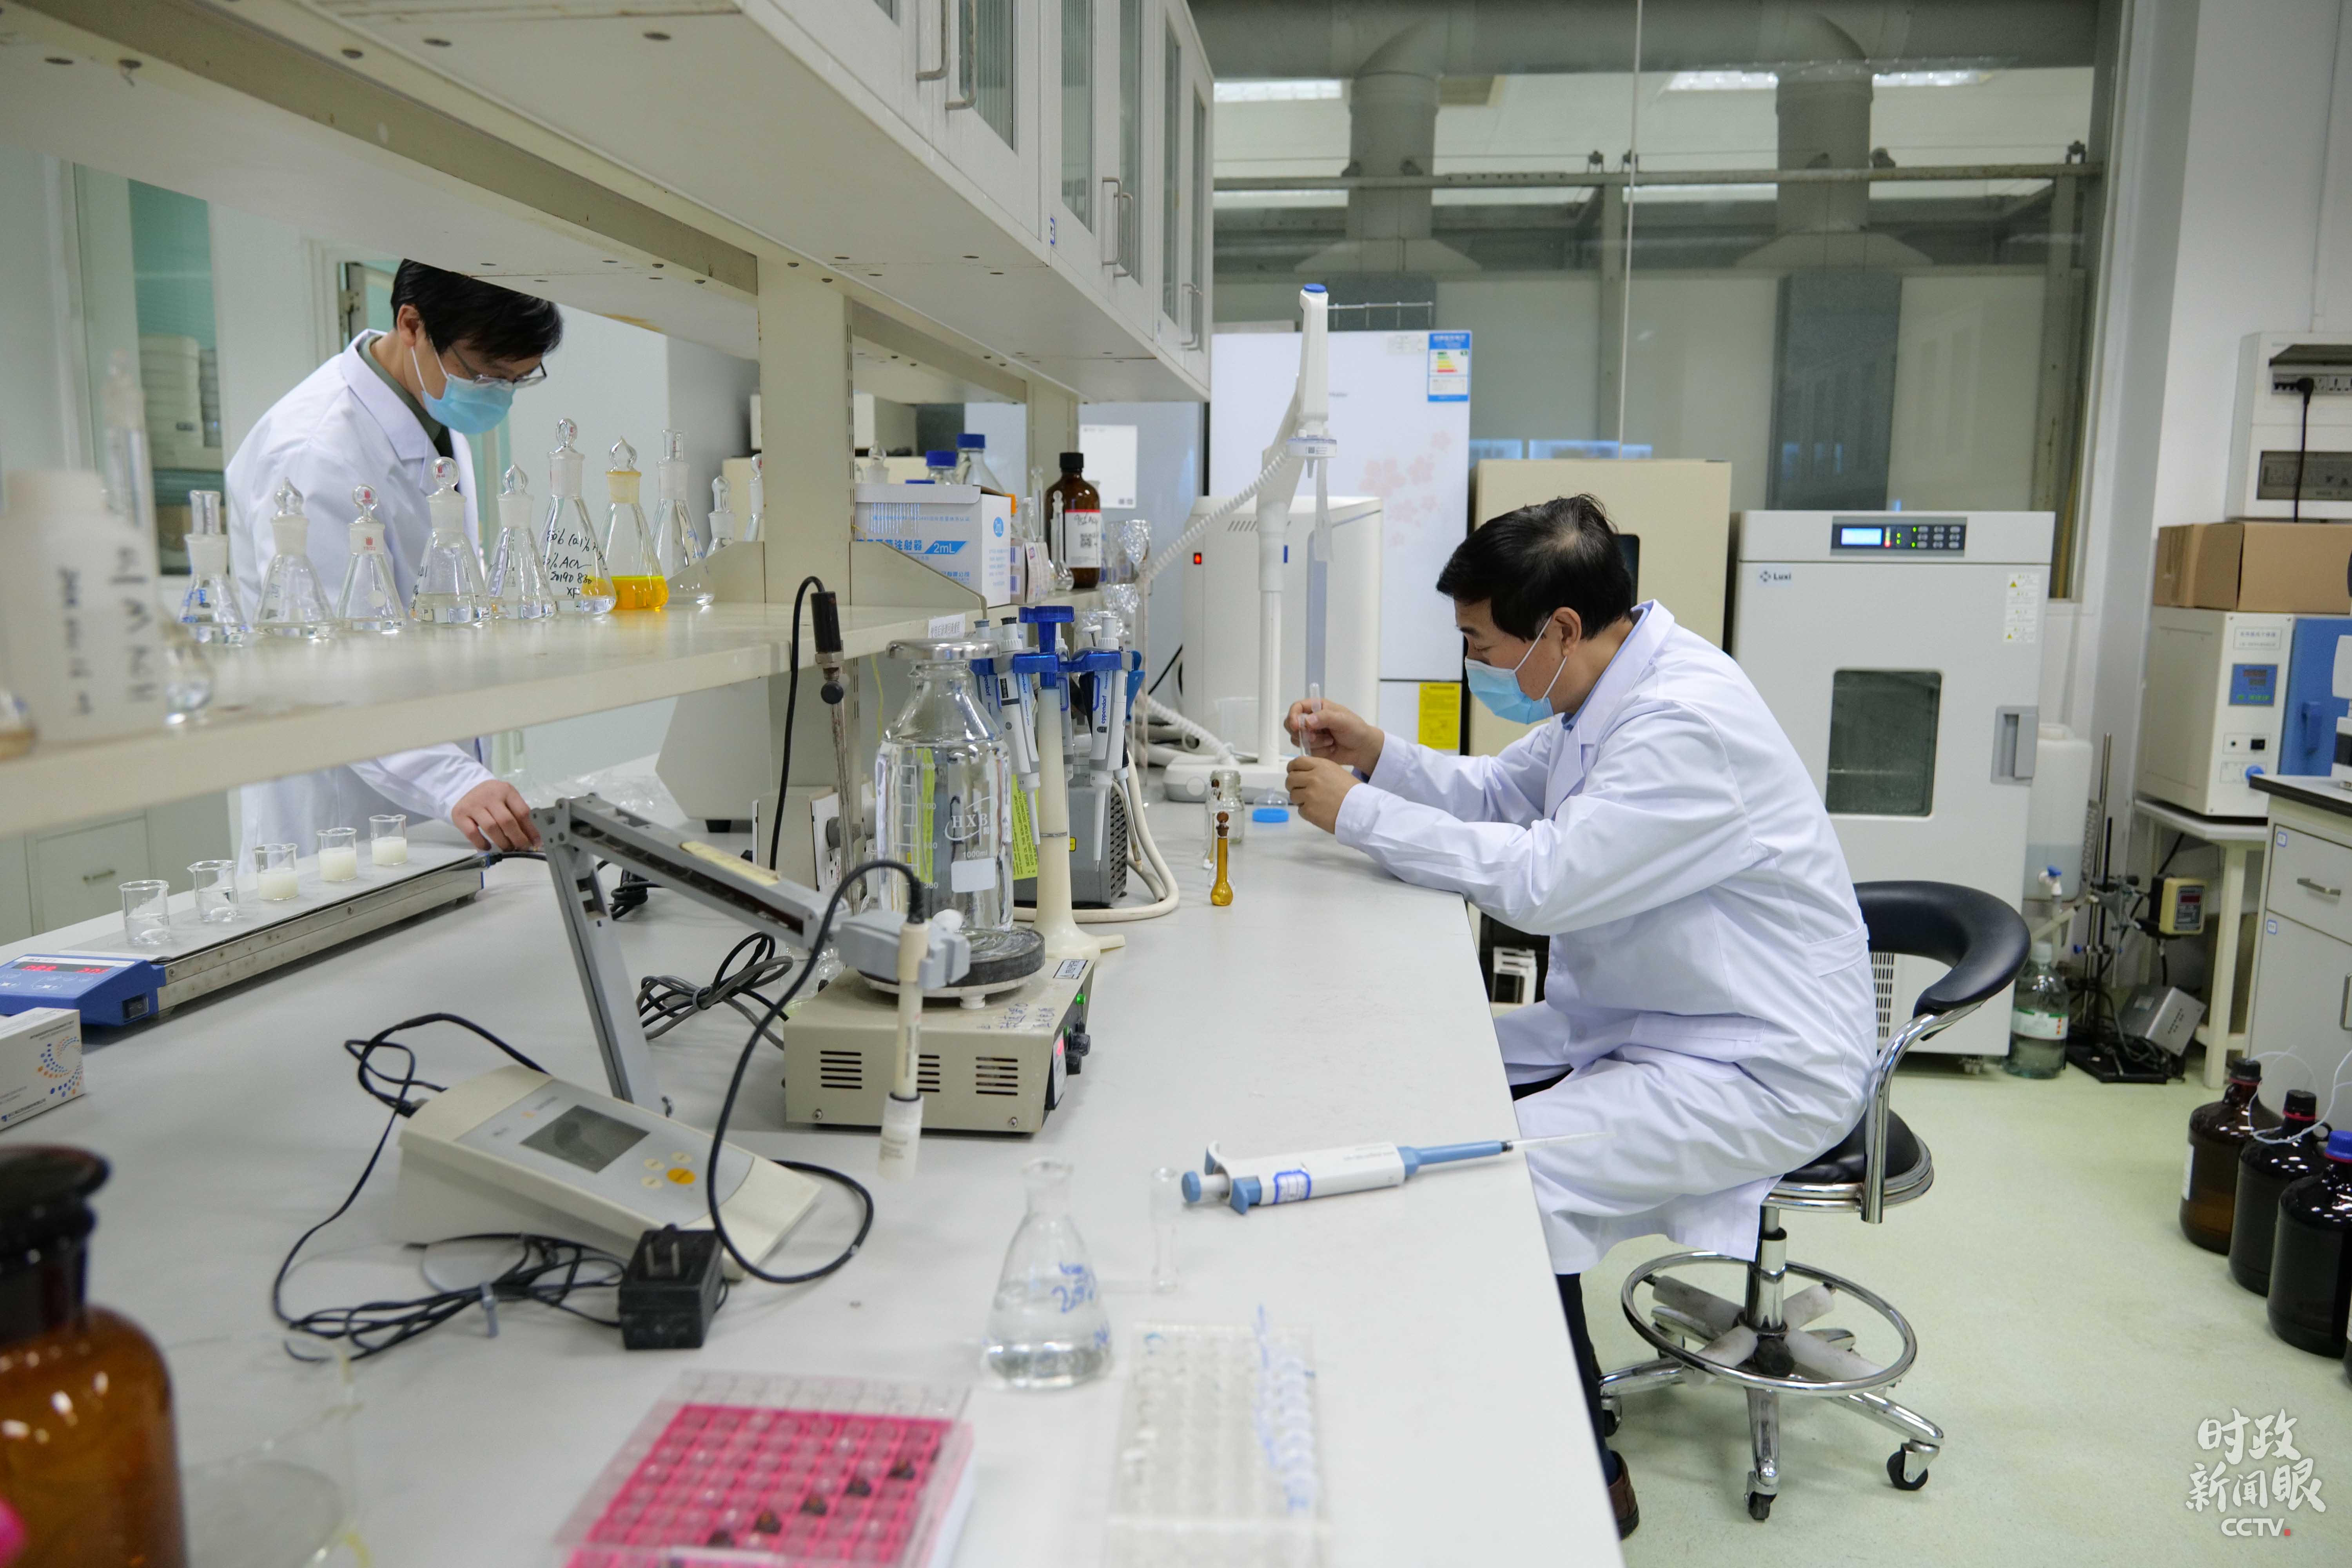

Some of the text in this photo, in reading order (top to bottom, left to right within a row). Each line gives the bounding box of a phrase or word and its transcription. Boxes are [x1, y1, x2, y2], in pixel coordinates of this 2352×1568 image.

[933, 543, 955, 553] 2mL
[983, 675, 991, 696] pendorf
[962, 849, 988, 858] 1000ml
